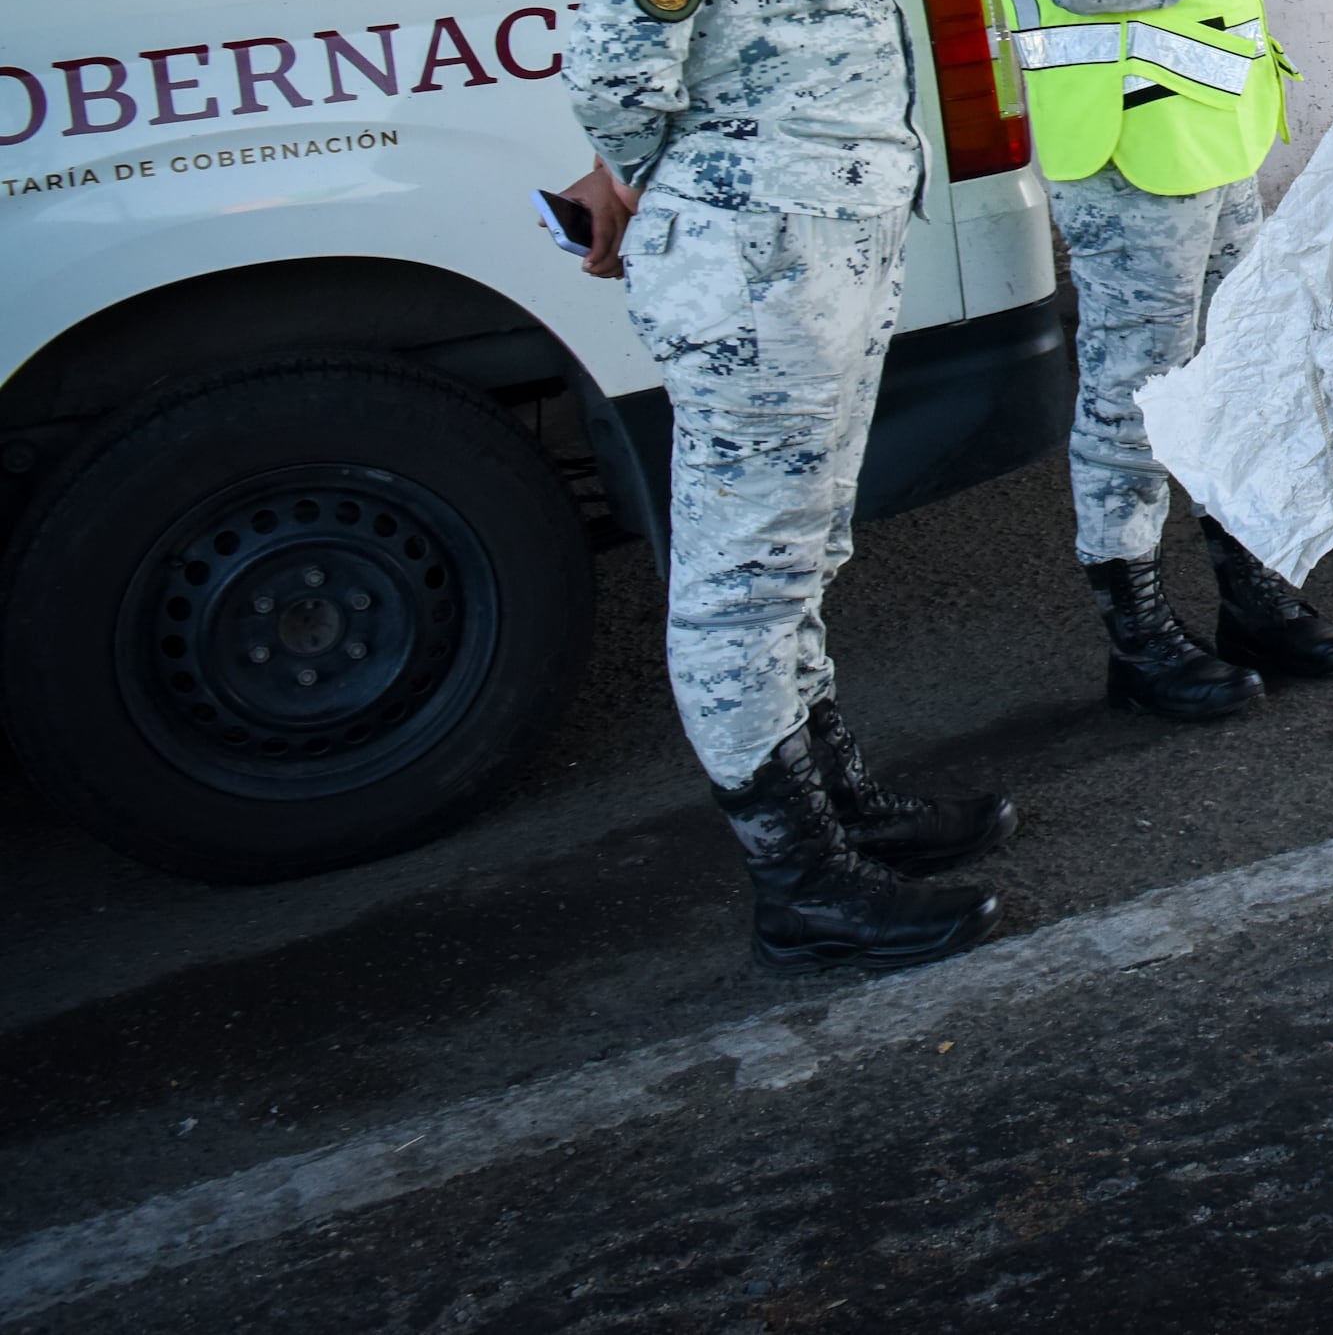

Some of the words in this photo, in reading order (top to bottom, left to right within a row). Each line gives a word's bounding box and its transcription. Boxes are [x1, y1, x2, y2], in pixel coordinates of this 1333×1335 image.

[0, 3, 581, 147] OBERNAC
[114, 160, 156, 181] DE
[170, 127, 400, 174] GOBERNACIÓN
